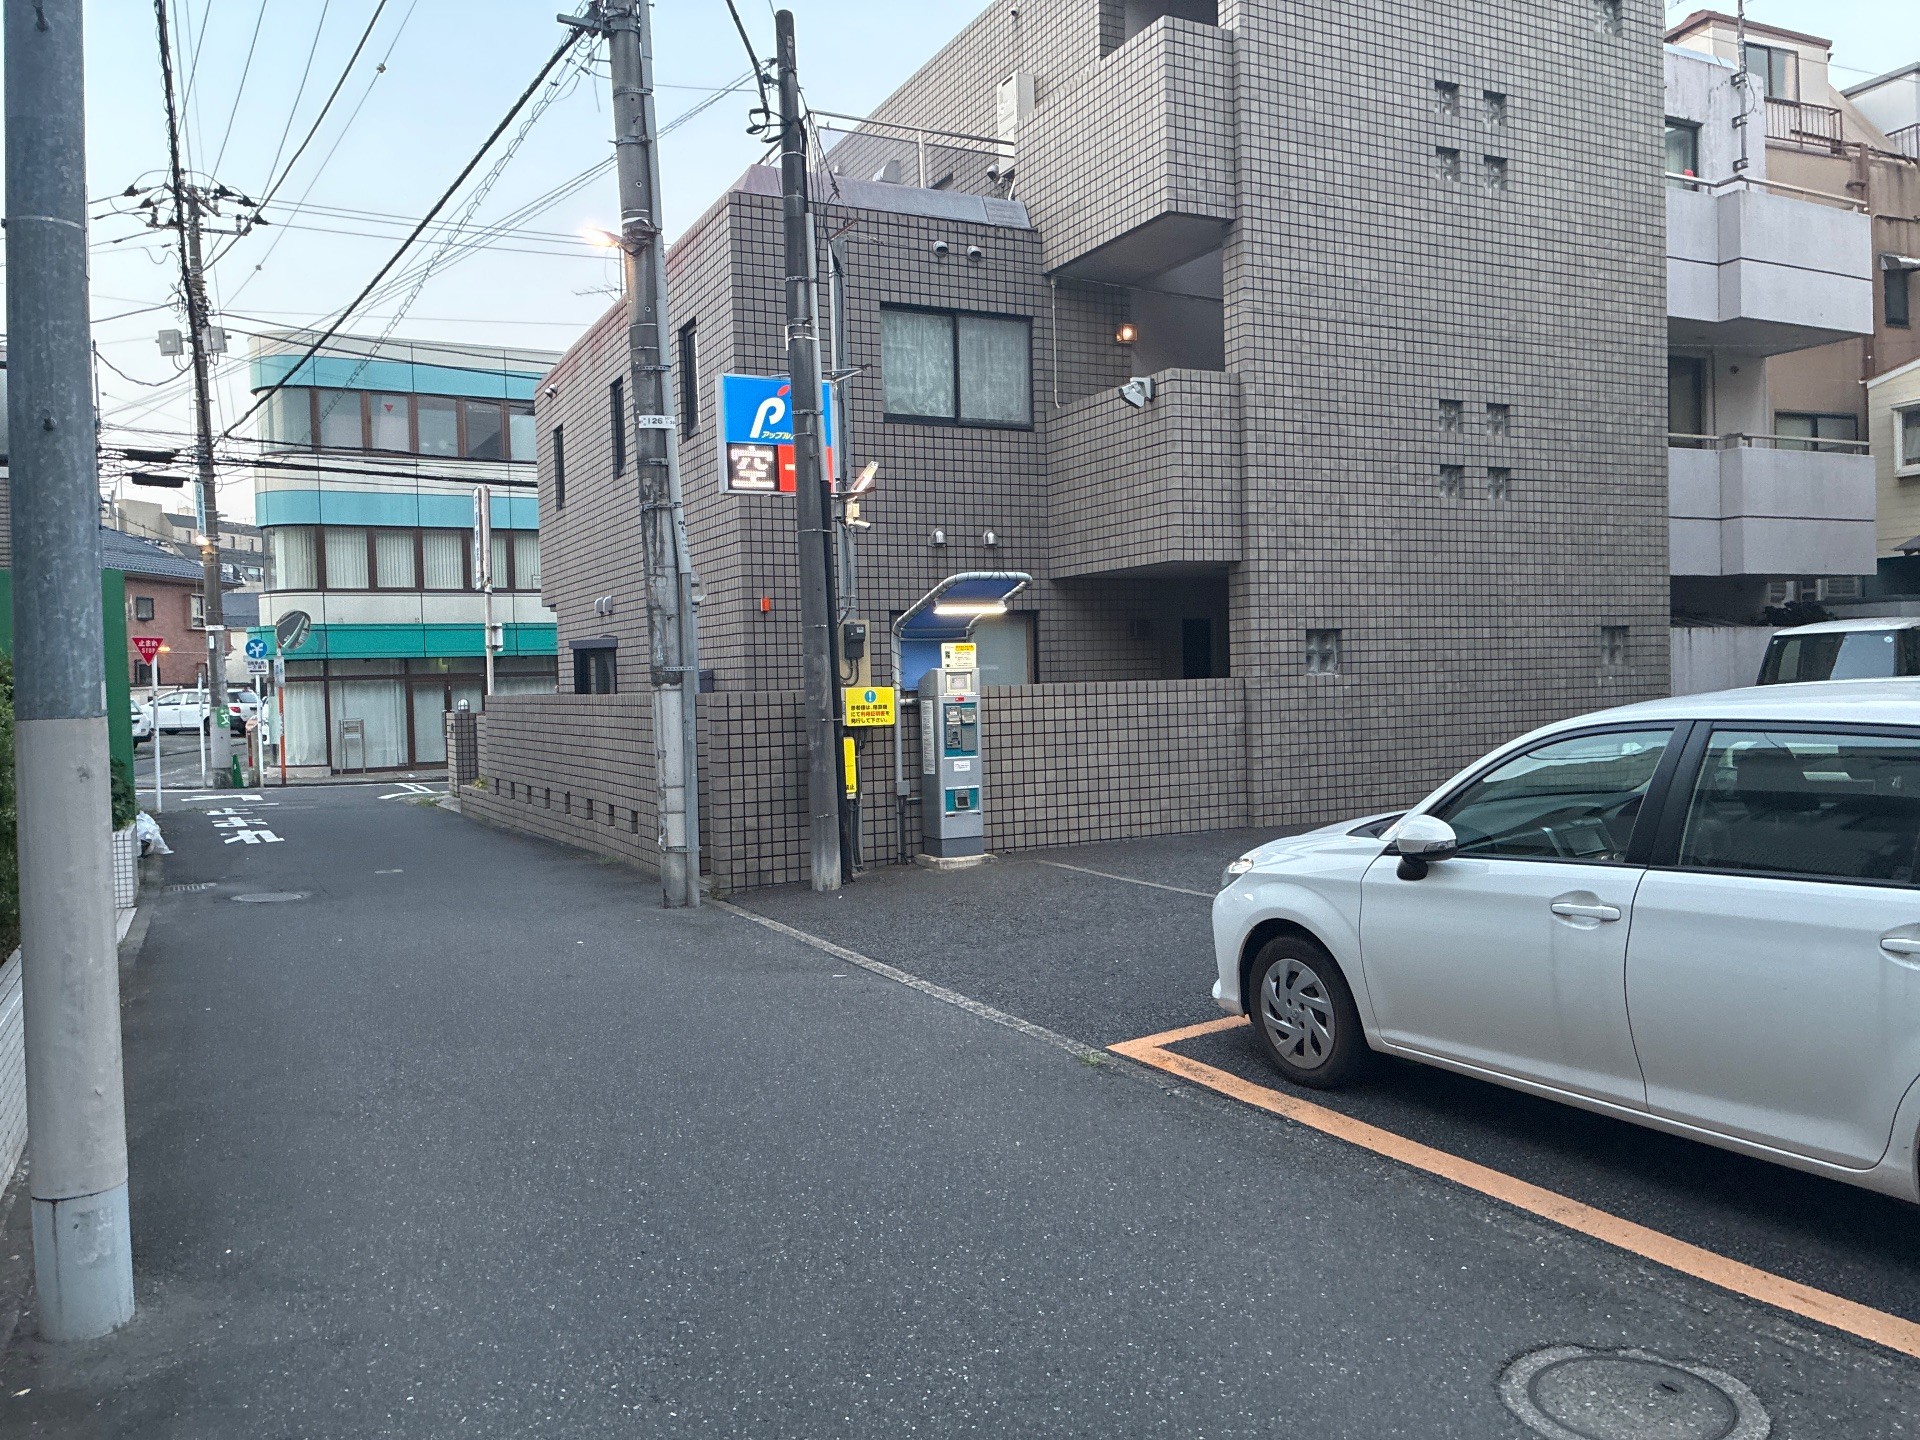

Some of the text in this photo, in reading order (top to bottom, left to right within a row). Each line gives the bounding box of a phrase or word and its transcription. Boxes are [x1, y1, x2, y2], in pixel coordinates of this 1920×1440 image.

[648, 417, 663, 425] 126
[730, 445, 775, 488] 空
[206, 807, 286, 844] 止まれ
